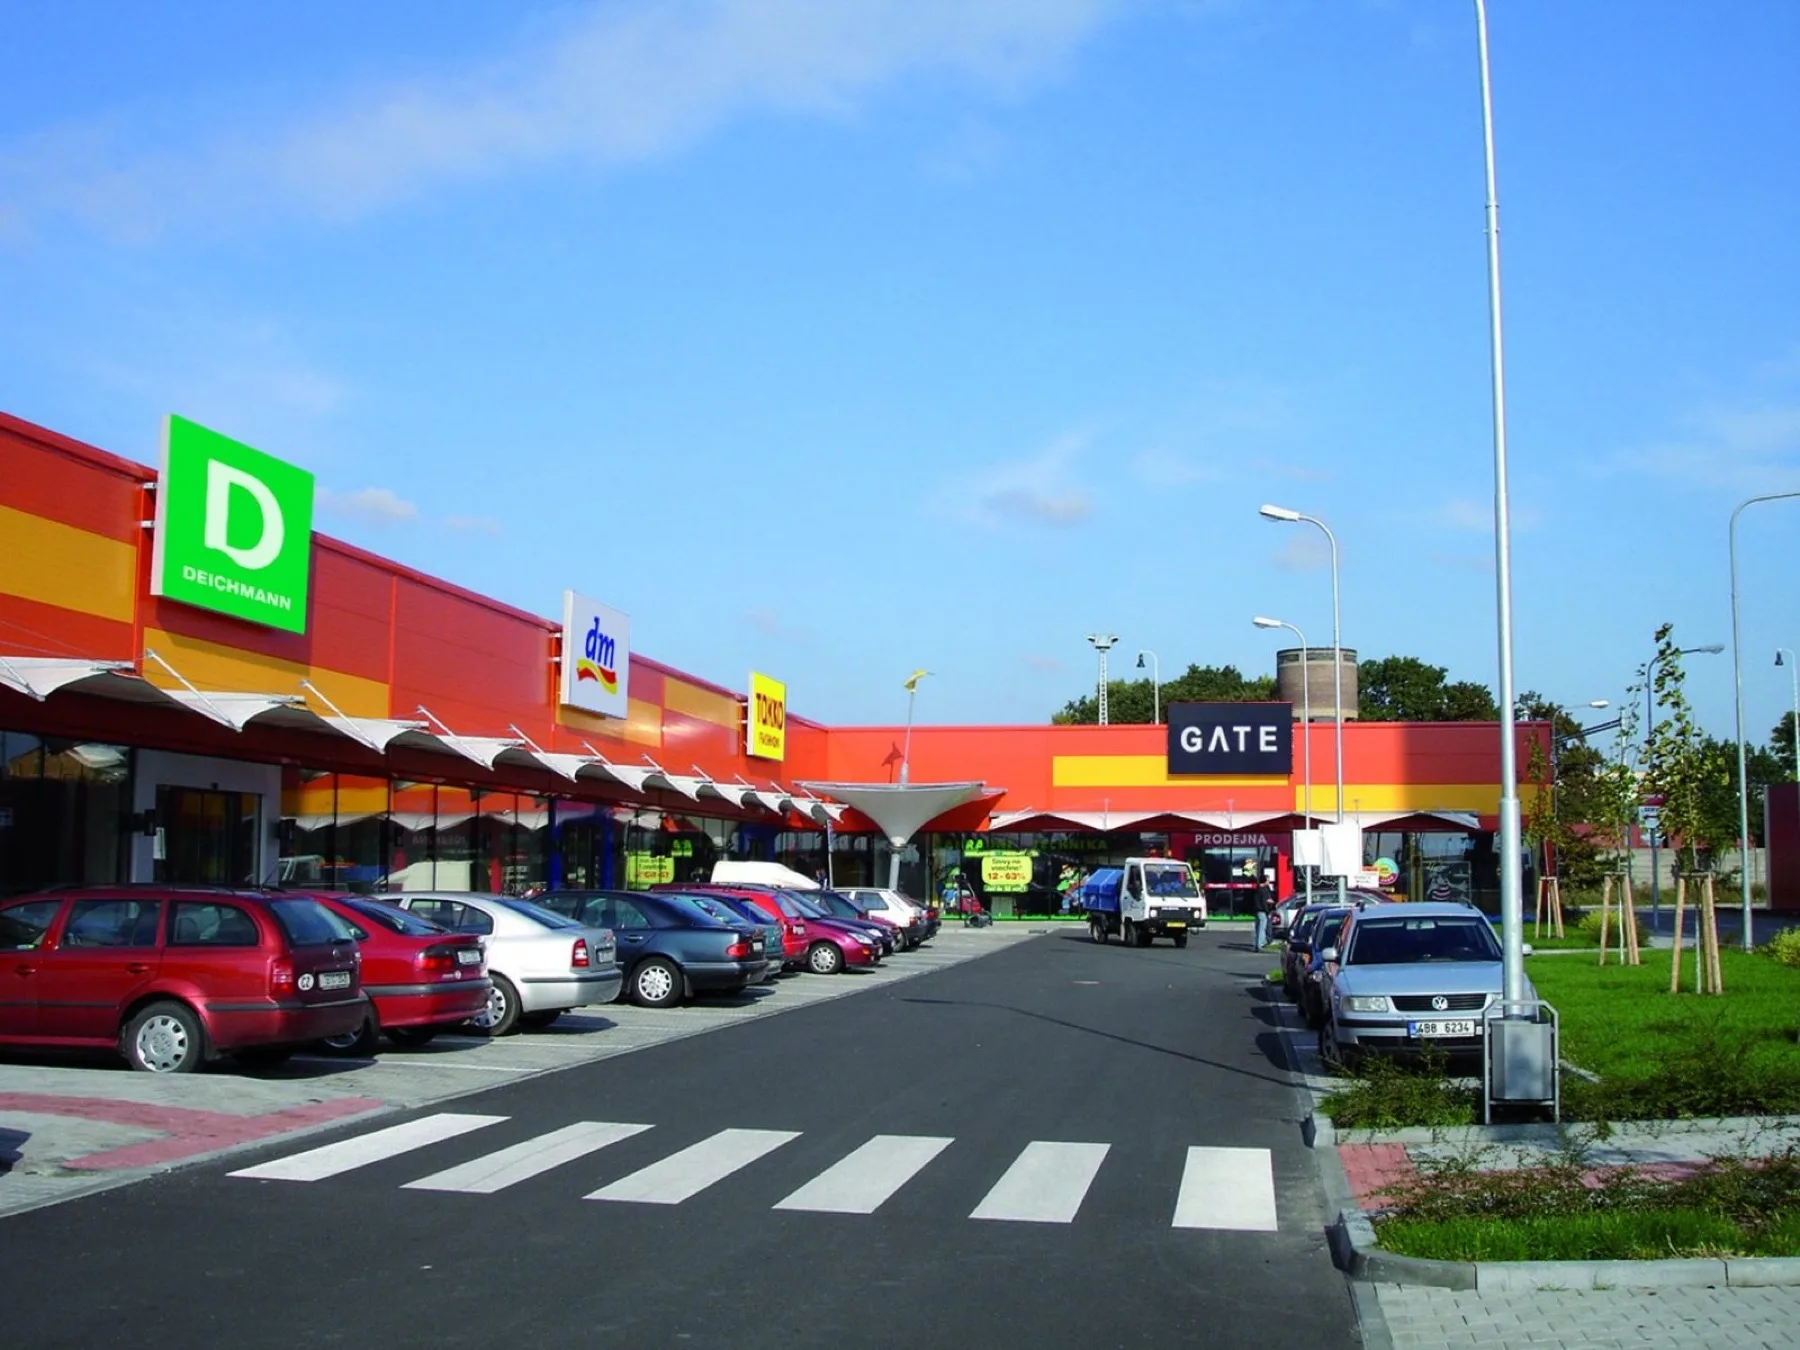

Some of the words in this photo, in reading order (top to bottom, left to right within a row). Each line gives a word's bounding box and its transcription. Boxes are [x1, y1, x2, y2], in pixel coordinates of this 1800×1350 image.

[205, 459, 285, 570] D
[183, 565, 291, 611] DEICHMANN
[585, 616, 615, 669] dm
[1180, 726, 1278, 753] GATE
[1195, 834, 1267, 845] PRODEJNA
[1445, 1023, 1469, 1033] 6234
